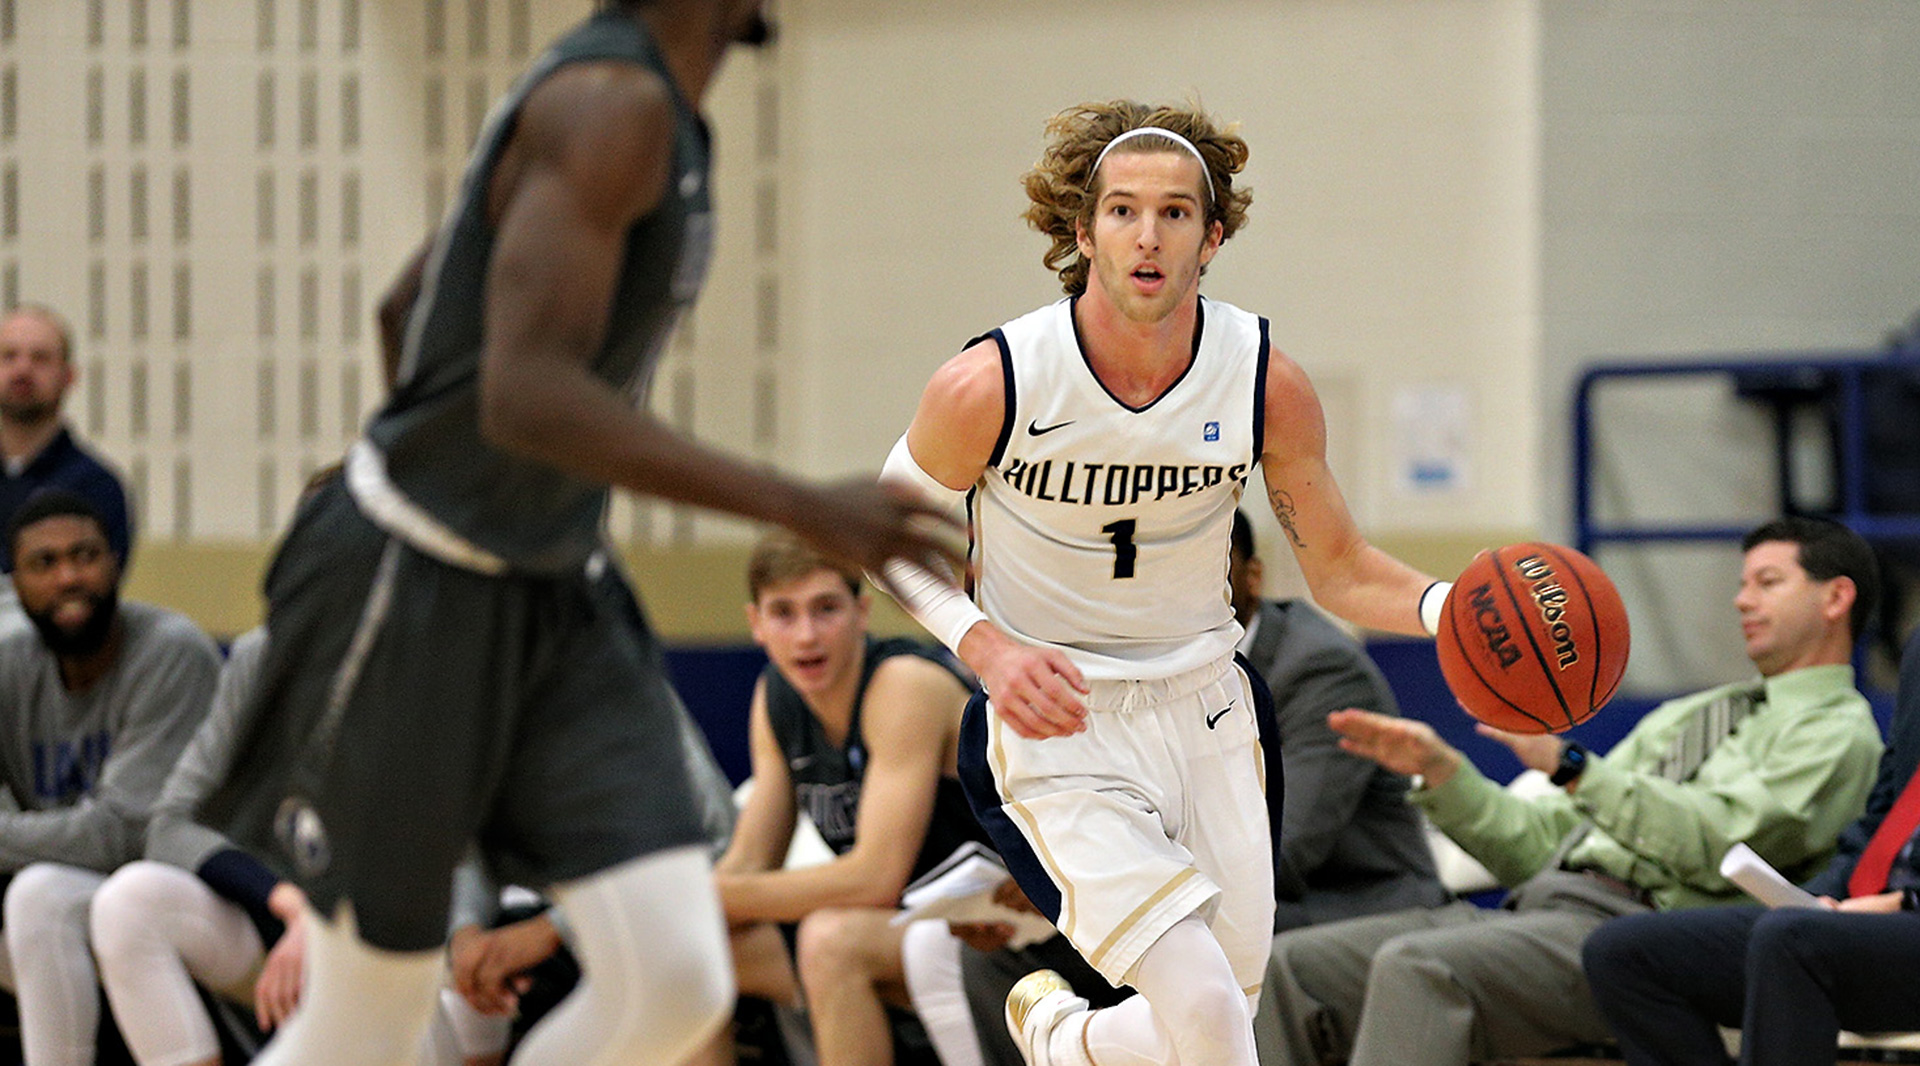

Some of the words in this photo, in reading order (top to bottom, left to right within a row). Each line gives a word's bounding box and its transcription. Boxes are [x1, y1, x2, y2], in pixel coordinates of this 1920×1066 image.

[1002, 459, 1248, 505] HILLTOPPERS
[1101, 517, 1137, 579] 1
[1469, 582, 1523, 670] NCAA
[1514, 553, 1579, 672] Wilson
